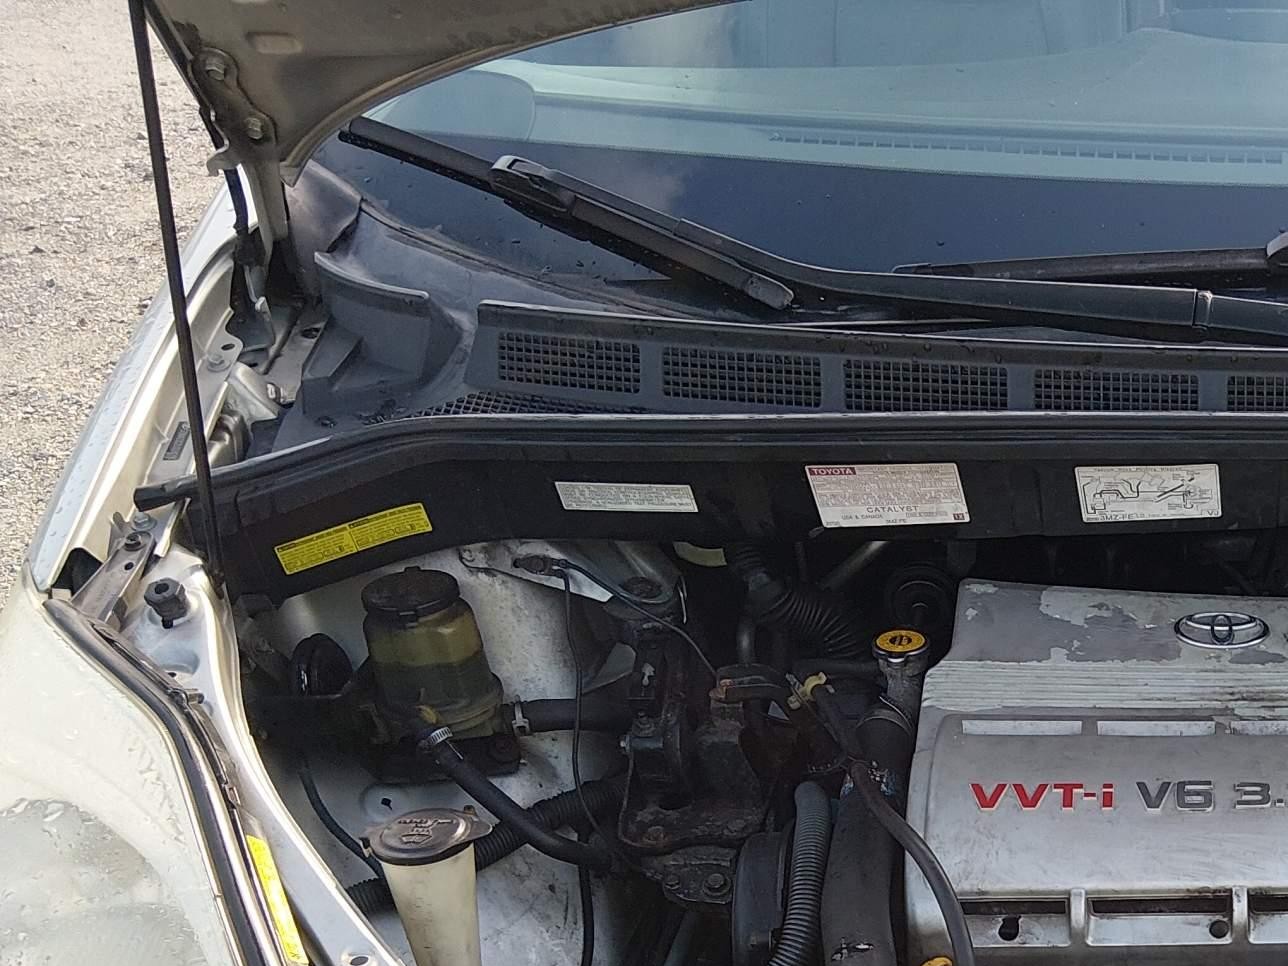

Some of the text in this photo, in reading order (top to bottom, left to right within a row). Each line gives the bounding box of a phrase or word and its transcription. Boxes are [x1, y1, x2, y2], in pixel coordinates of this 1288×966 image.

[812, 467, 854, 475] TOYOTA
[866, 505, 920, 514] CATALYST
[969, 782, 1115, 810] VVT-i
[1136, 780, 1216, 812] V6
